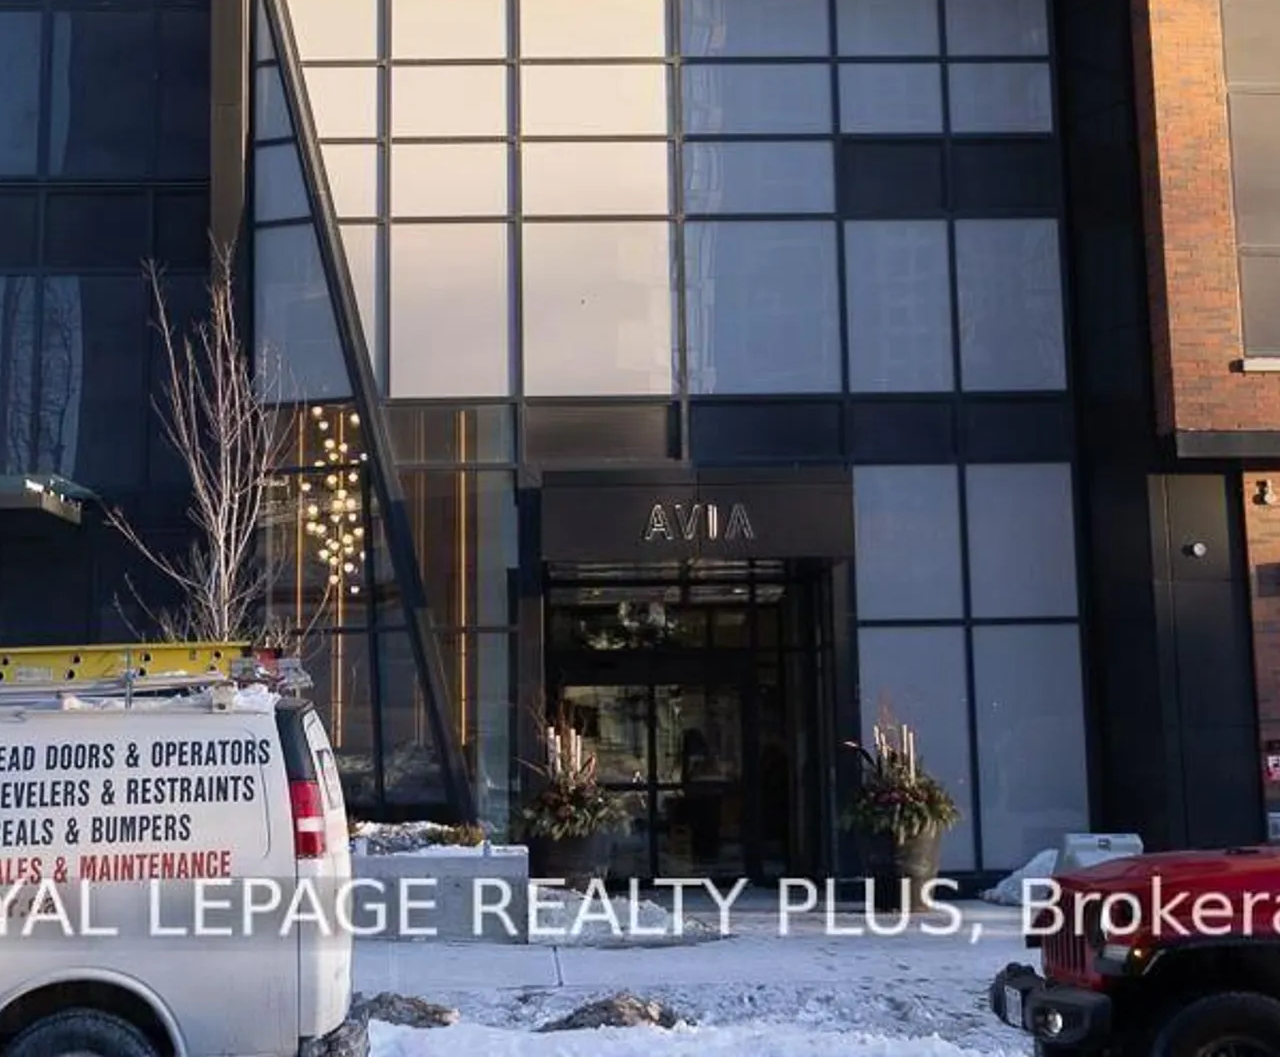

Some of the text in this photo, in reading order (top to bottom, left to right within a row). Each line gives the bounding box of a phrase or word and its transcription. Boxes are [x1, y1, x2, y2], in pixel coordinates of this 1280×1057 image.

[644, 504, 755, 540] AVIA
[46, 743, 116, 771] DOORS
[124, 743, 140, 769] &
[151, 739, 271, 768] OPERATORS
[101, 779, 116, 806] &
[126, 775, 256, 806] RESTRAINTS
[65, 817, 80, 845] &
[91, 814, 192, 844] BUMPERS
[53, 856, 68, 882] &
[80, 850, 232, 883] MAINTENANCE
